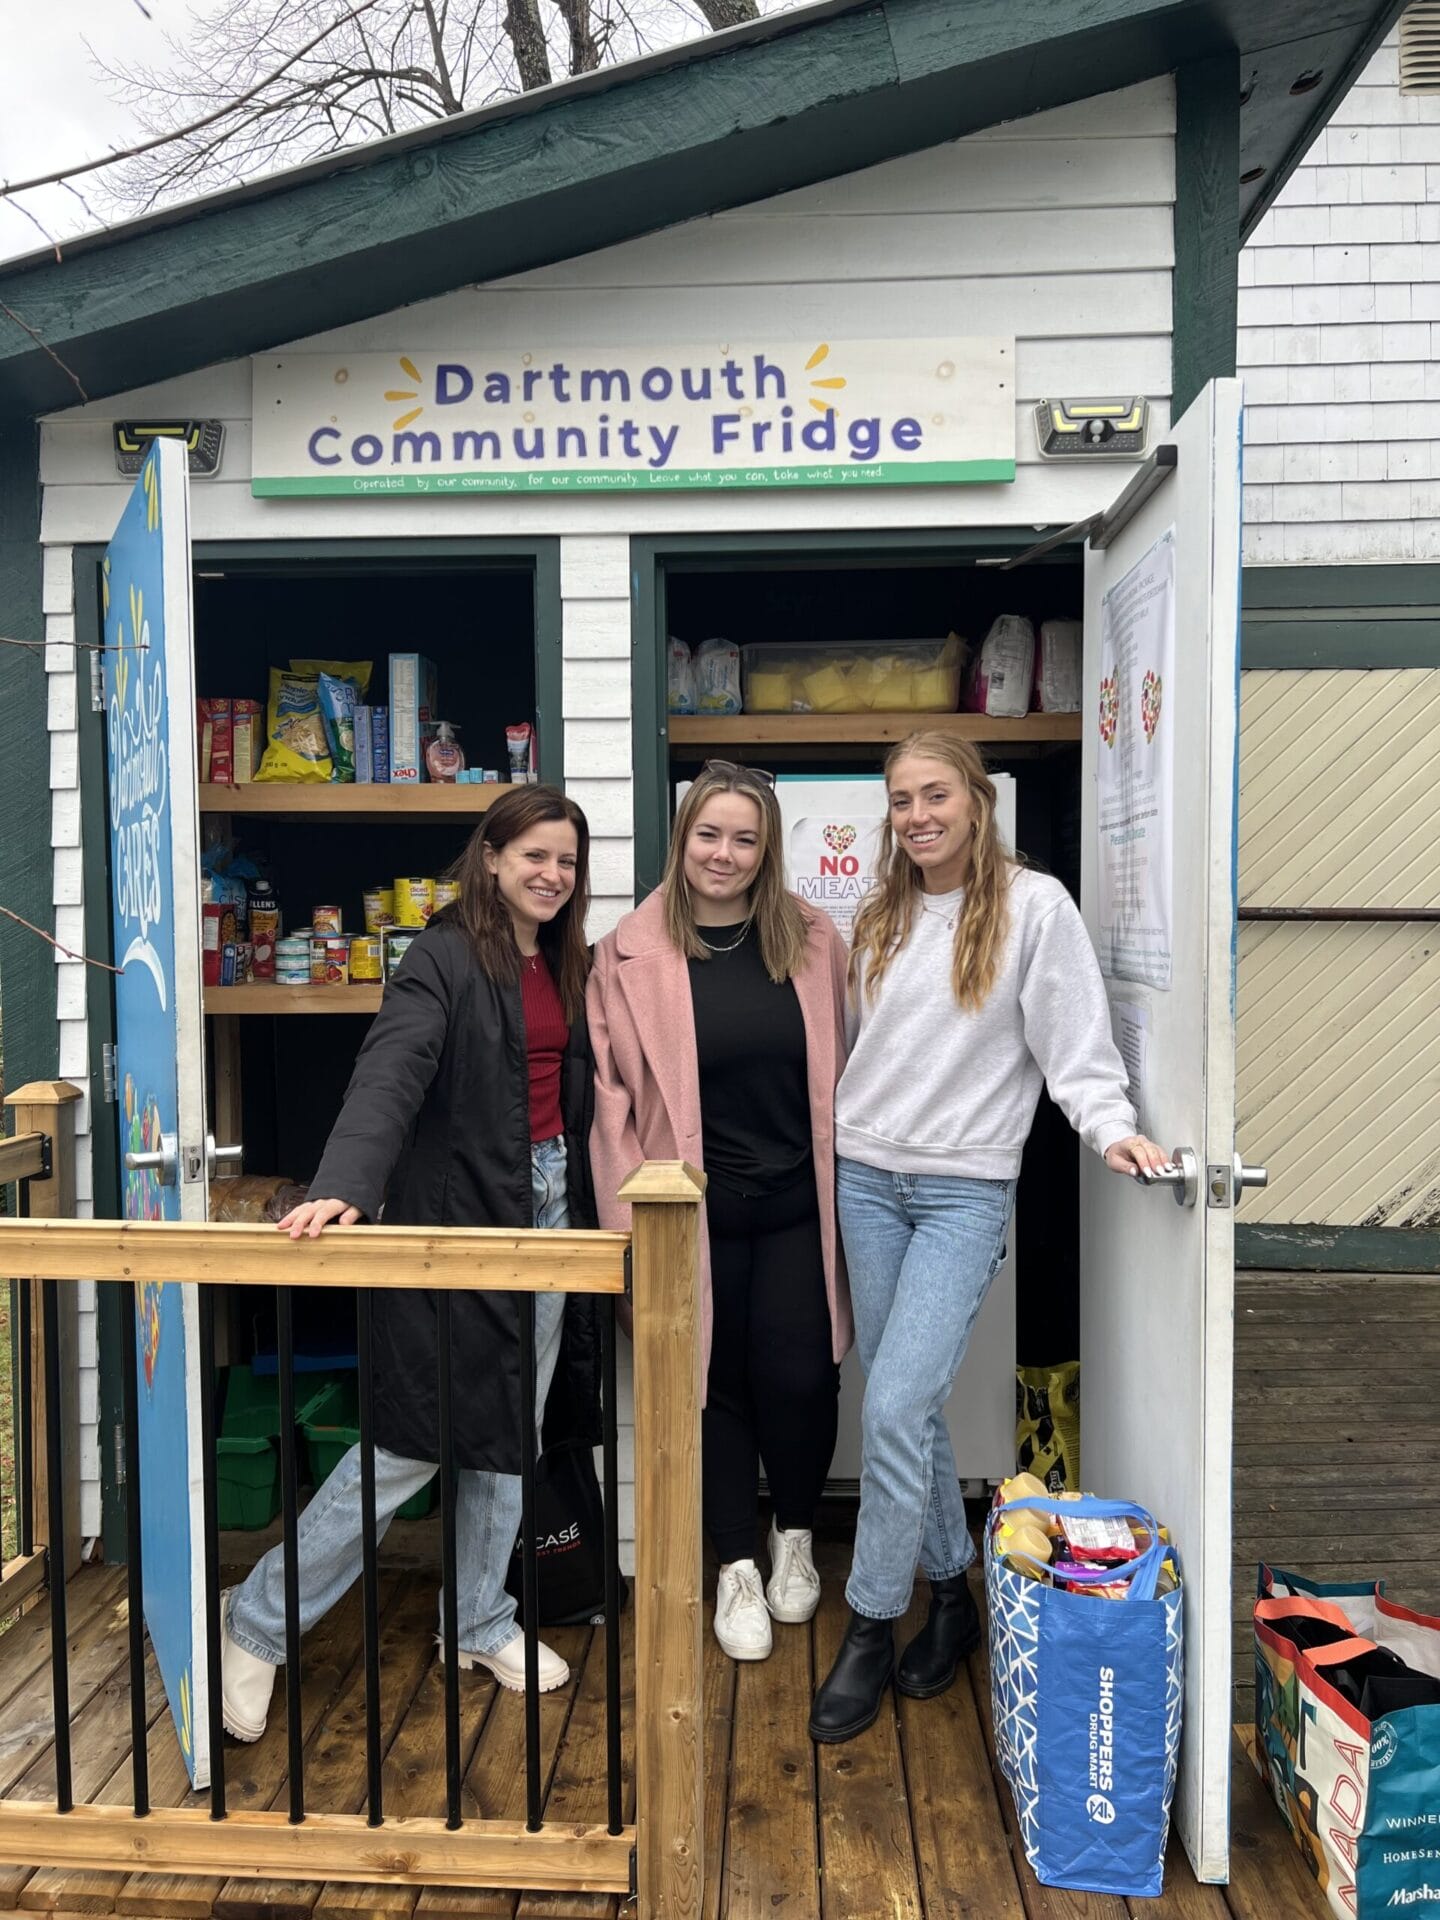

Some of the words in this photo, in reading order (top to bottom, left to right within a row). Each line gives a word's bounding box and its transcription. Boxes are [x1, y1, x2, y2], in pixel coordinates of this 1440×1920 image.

[435, 354, 786, 405] Dartmouth
[308, 414, 680, 468] Community
[712, 405, 923, 460] Fridge
[353, 476, 406, 492] Operated
[416, 476, 431, 491] by
[437, 478, 457, 487] our
[527, 473, 544, 486] for
[551, 476, 570, 485] our
[649, 471, 681, 483] Leave
[688, 471, 713, 483] what
[718, 473, 738, 485] you
[745, 471, 768, 483] can,
[773, 468, 800, 481] take
[806, 467, 833, 481] what
[841, 469, 859, 482] you
[110, 619, 167, 831] Dartmouth
[392, 767, 418, 779] Chex
[117, 803, 161, 939] CARES
[820, 856, 859, 876] NO
[1089, 1713, 1098, 1750] DRUG
[1099, 1666, 1114, 1792] SHOPPERS
[1089, 1752, 1098, 1790] MART
[1386, 1814, 1440, 1829] WINNE
